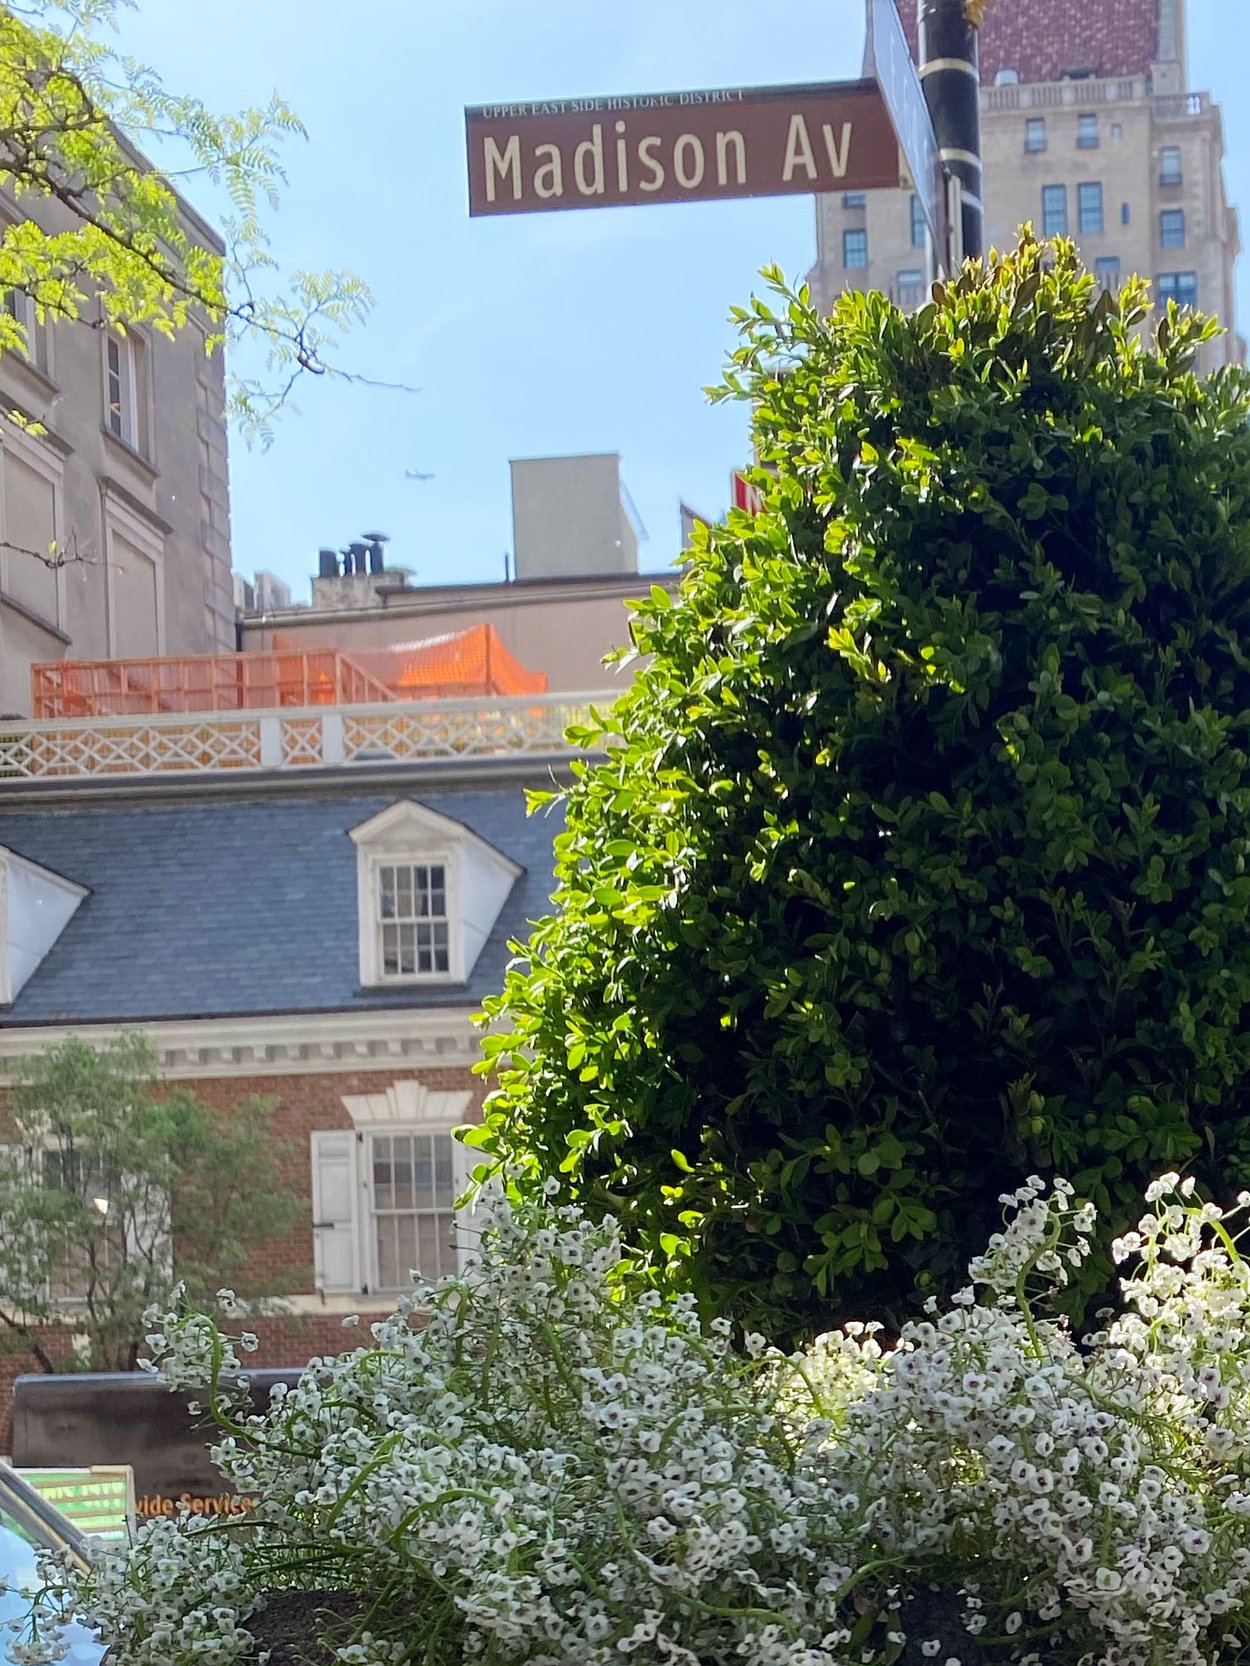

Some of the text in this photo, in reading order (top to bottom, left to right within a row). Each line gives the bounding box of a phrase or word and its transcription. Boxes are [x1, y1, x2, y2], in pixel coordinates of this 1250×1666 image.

[482, 89, 745, 118] UPPER EAST SIDE HISTORIC DISTRICT
[483, 113, 853, 202] Madison Av
